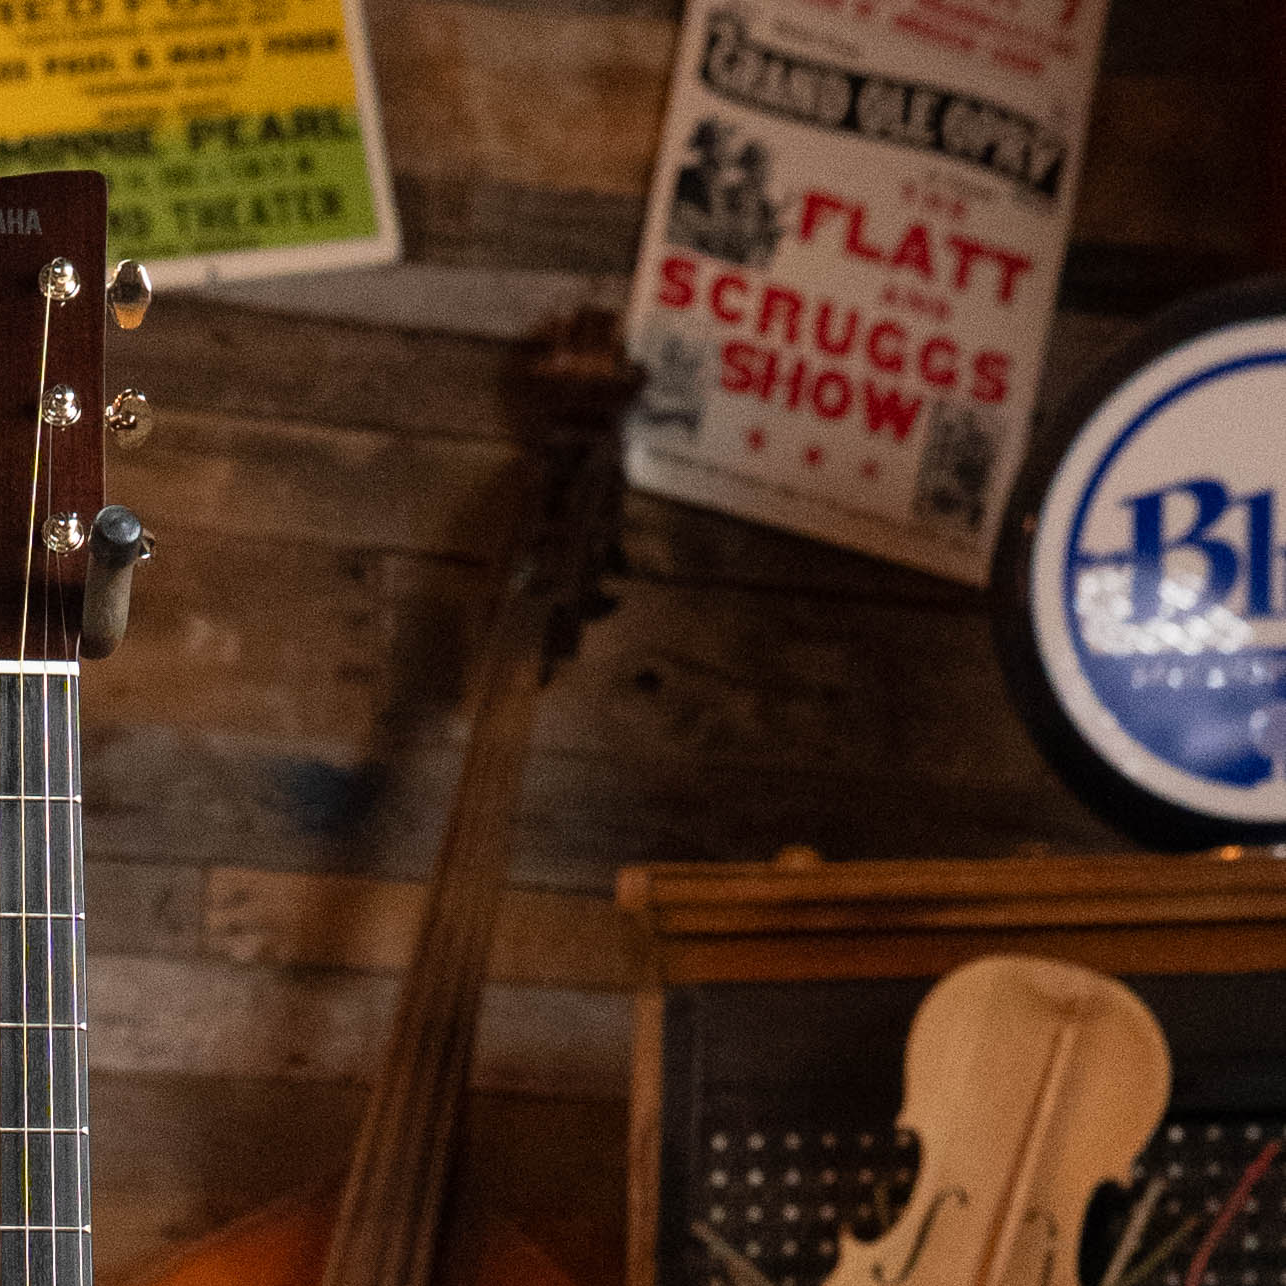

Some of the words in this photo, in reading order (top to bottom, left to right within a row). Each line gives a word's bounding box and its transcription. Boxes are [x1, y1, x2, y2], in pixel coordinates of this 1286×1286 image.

[799, 190, 1035, 308] FLATT
[656, 256, 1011, 403] SCRUGGS
[719, 340, 923, 444] SHOW
[1123, 478, 1286, 620] Bl
